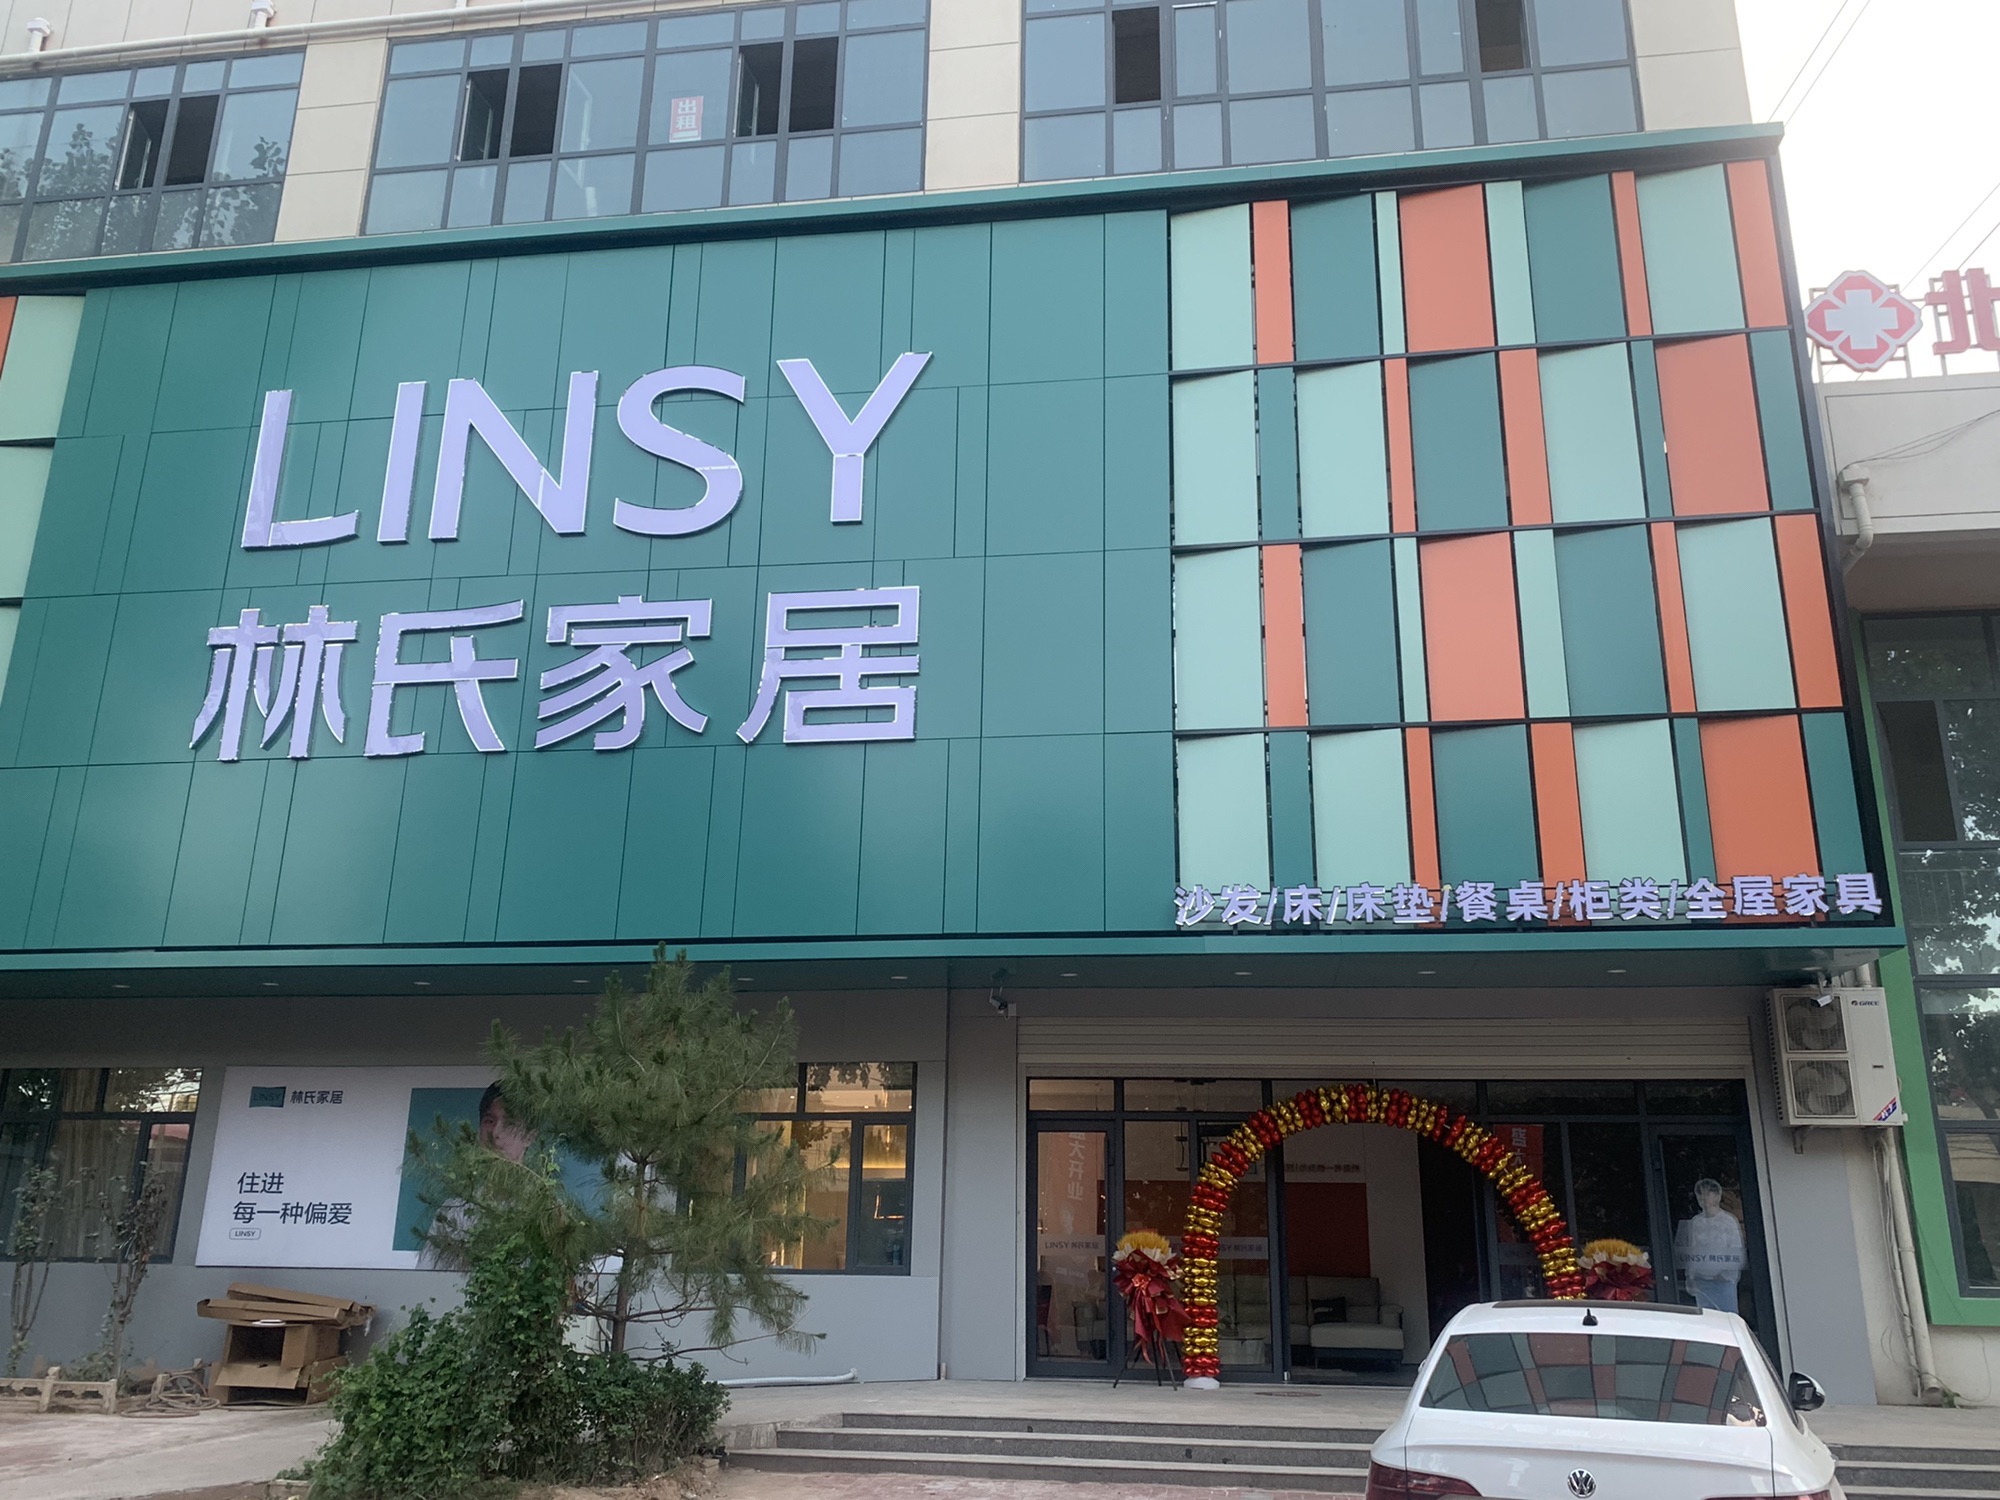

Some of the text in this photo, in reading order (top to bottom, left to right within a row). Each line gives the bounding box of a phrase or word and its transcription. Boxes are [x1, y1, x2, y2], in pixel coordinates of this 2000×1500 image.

[676, 99, 697, 130] 出租
[241, 351, 933, 548] LINSY
[189, 585, 920, 762] 林氏家居
[290, 1090, 344, 1104] 林氏家居
[237, 1172, 284, 1194] 住进
[232, 1201, 352, 1225] 每一种偏爱
[235, 1229, 256, 1237] LINSY
